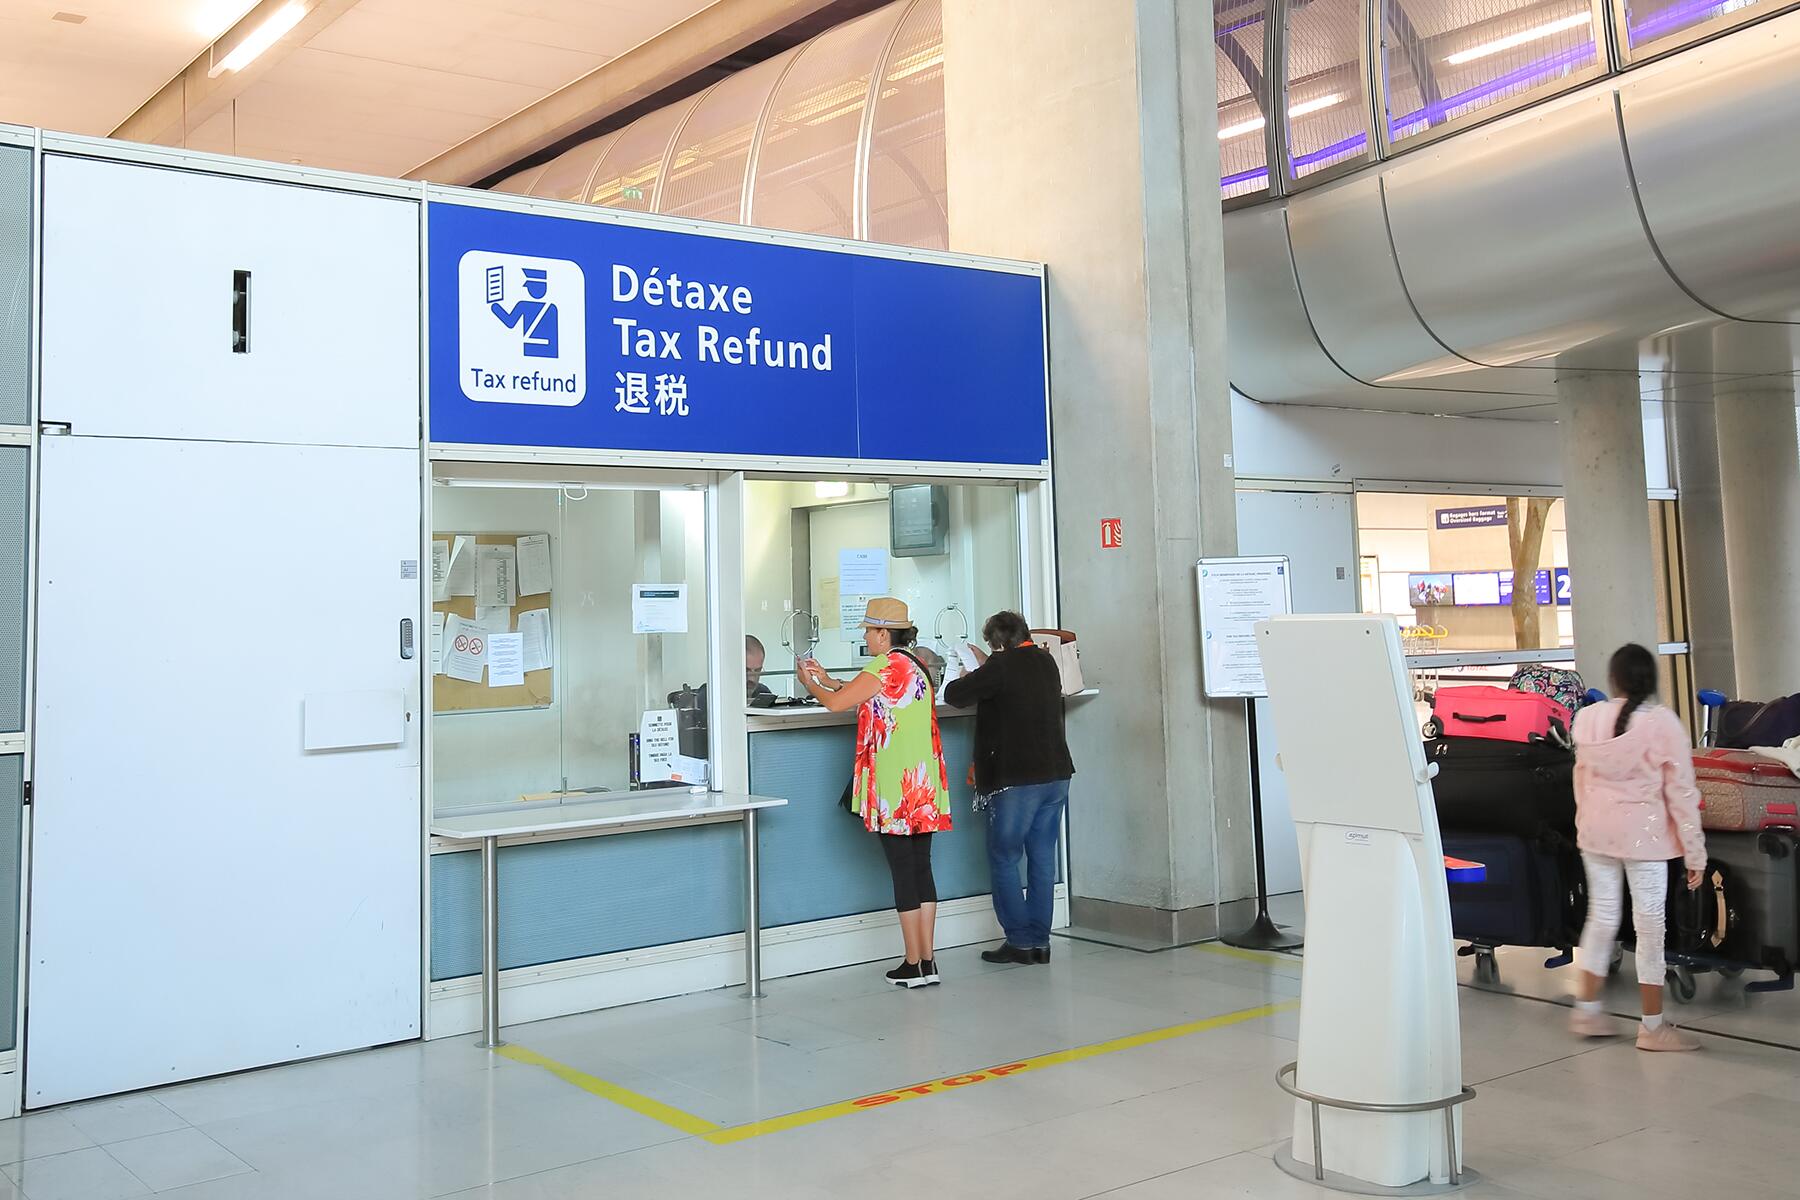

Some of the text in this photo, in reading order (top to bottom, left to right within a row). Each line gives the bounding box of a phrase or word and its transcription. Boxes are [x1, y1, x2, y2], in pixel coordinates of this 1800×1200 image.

[612, 264, 753, 315] Détaxe
[612, 317, 832, 371] Tax Refund
[470, 367, 576, 393] Tax refund
[614, 371, 690, 417] 退税
[853, 1063, 1027, 1107] STOP
